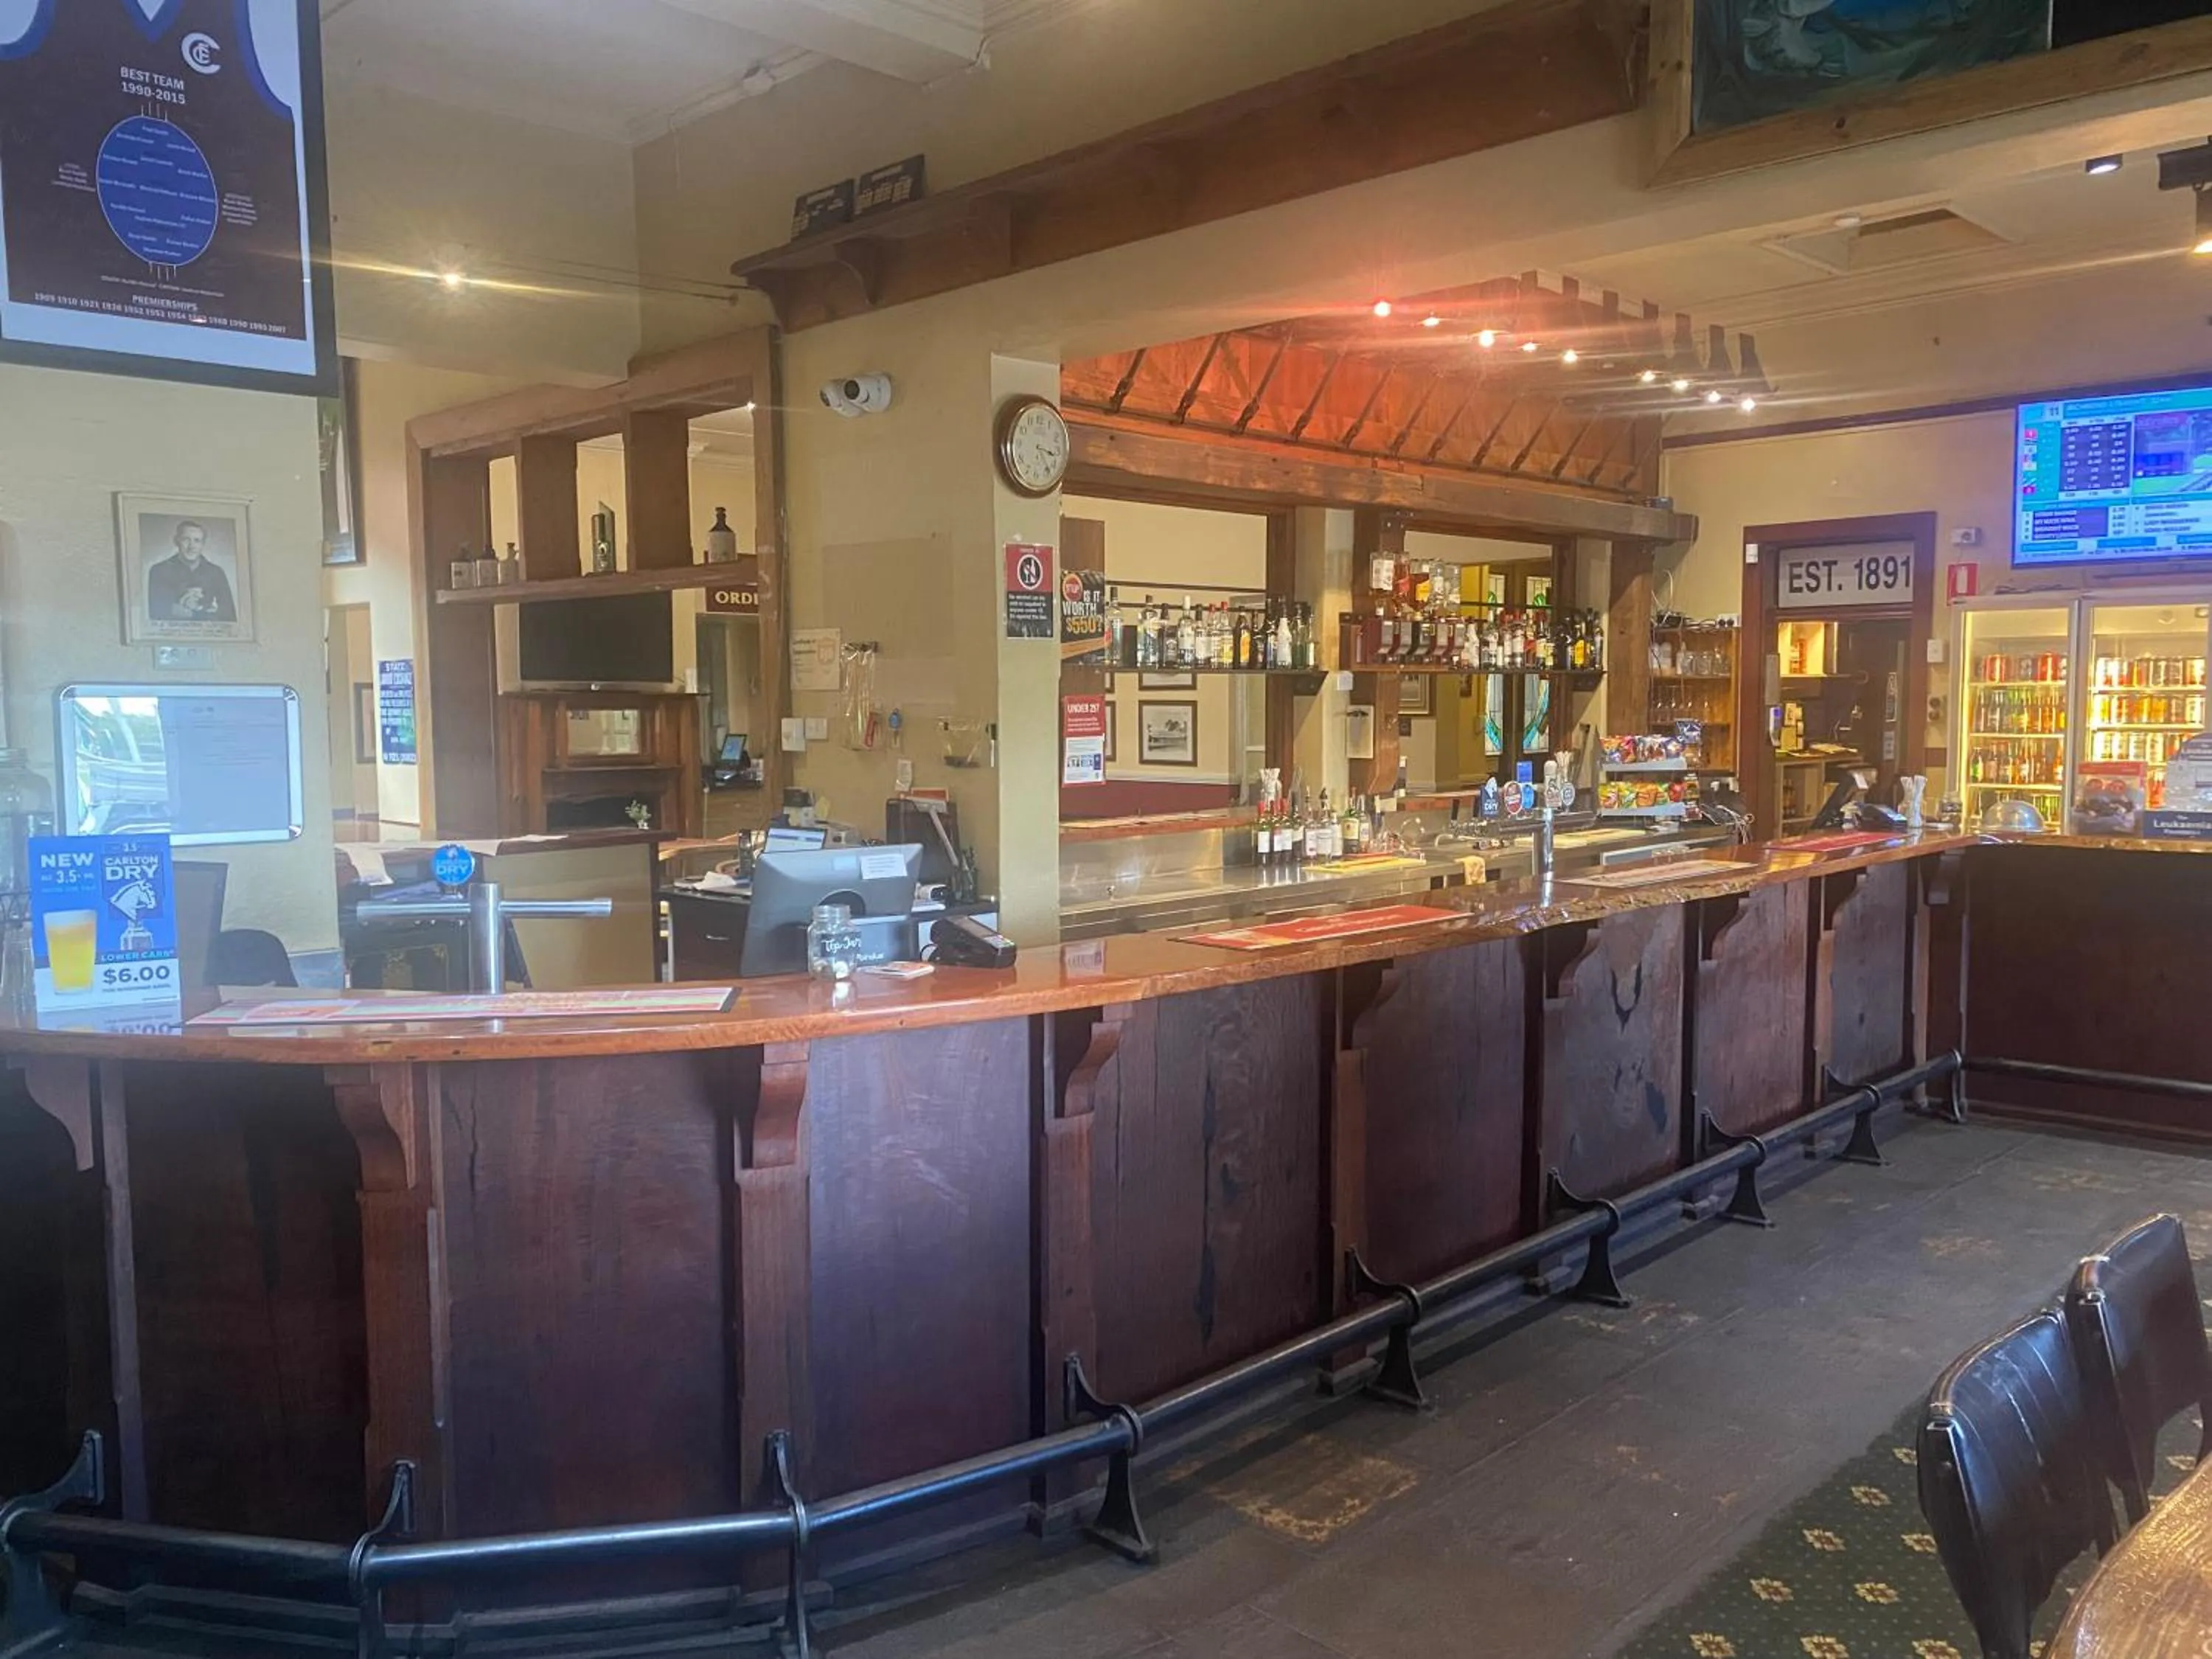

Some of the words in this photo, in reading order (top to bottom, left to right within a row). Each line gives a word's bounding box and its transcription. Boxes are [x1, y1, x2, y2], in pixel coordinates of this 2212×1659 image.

[120, 66, 150, 83] BEST
[153, 73, 184, 91] TEAM
[121, 80, 186, 105] 1990-2015
[132, 294, 198, 311] PREMIERSHIPS
[1789, 560, 1843, 594] EST.
[1854, 555, 1910, 590] 1891
[1083, 589, 1091, 602] IS
[1093, 590, 1101, 602] IT
[1062, 601, 1097, 616] WORTH
[1065, 615, 1103, 635] $550?
[1067, 703, 1089, 714] UNDER
[2153, 818, 2212, 830] Leukaemia
[41, 852, 94, 869] NEW
[104, 855, 159, 866] CARLTON
[105, 863, 159, 881] DRY
[102, 953, 139, 964] LOWER
[102, 965, 170, 985] $6.00
